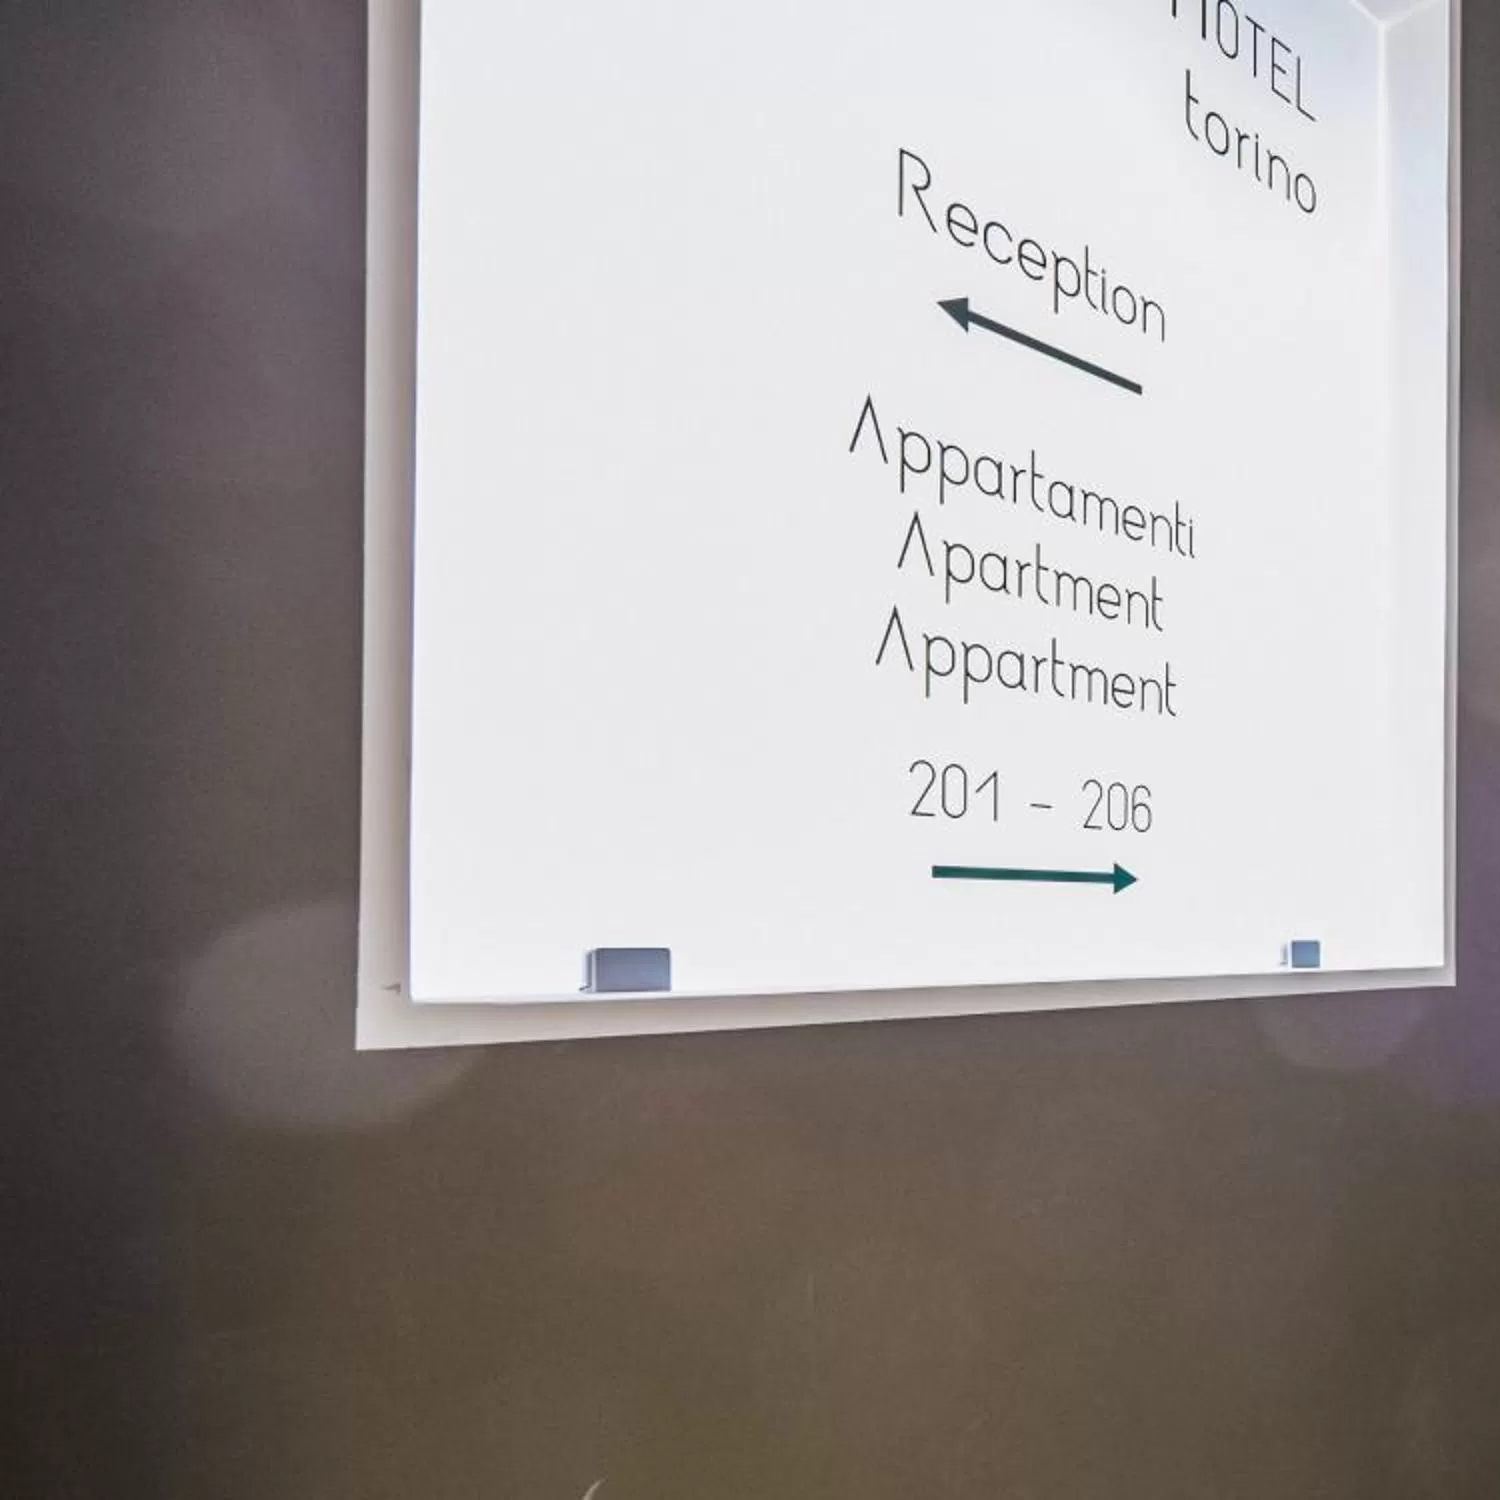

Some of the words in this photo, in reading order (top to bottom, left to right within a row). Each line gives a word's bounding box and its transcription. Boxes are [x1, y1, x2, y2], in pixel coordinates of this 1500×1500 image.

[1185, 69, 1317, 214] torino
[898, 148, 1165, 342] Reception
[849, 394, 1196, 559] Appartamenti
[898, 511, 1163, 632] Apartment
[876, 605, 1177, 717] Appartment
[909, 759, 998, 822] 201
[1082, 779, 1152, 833] 206
